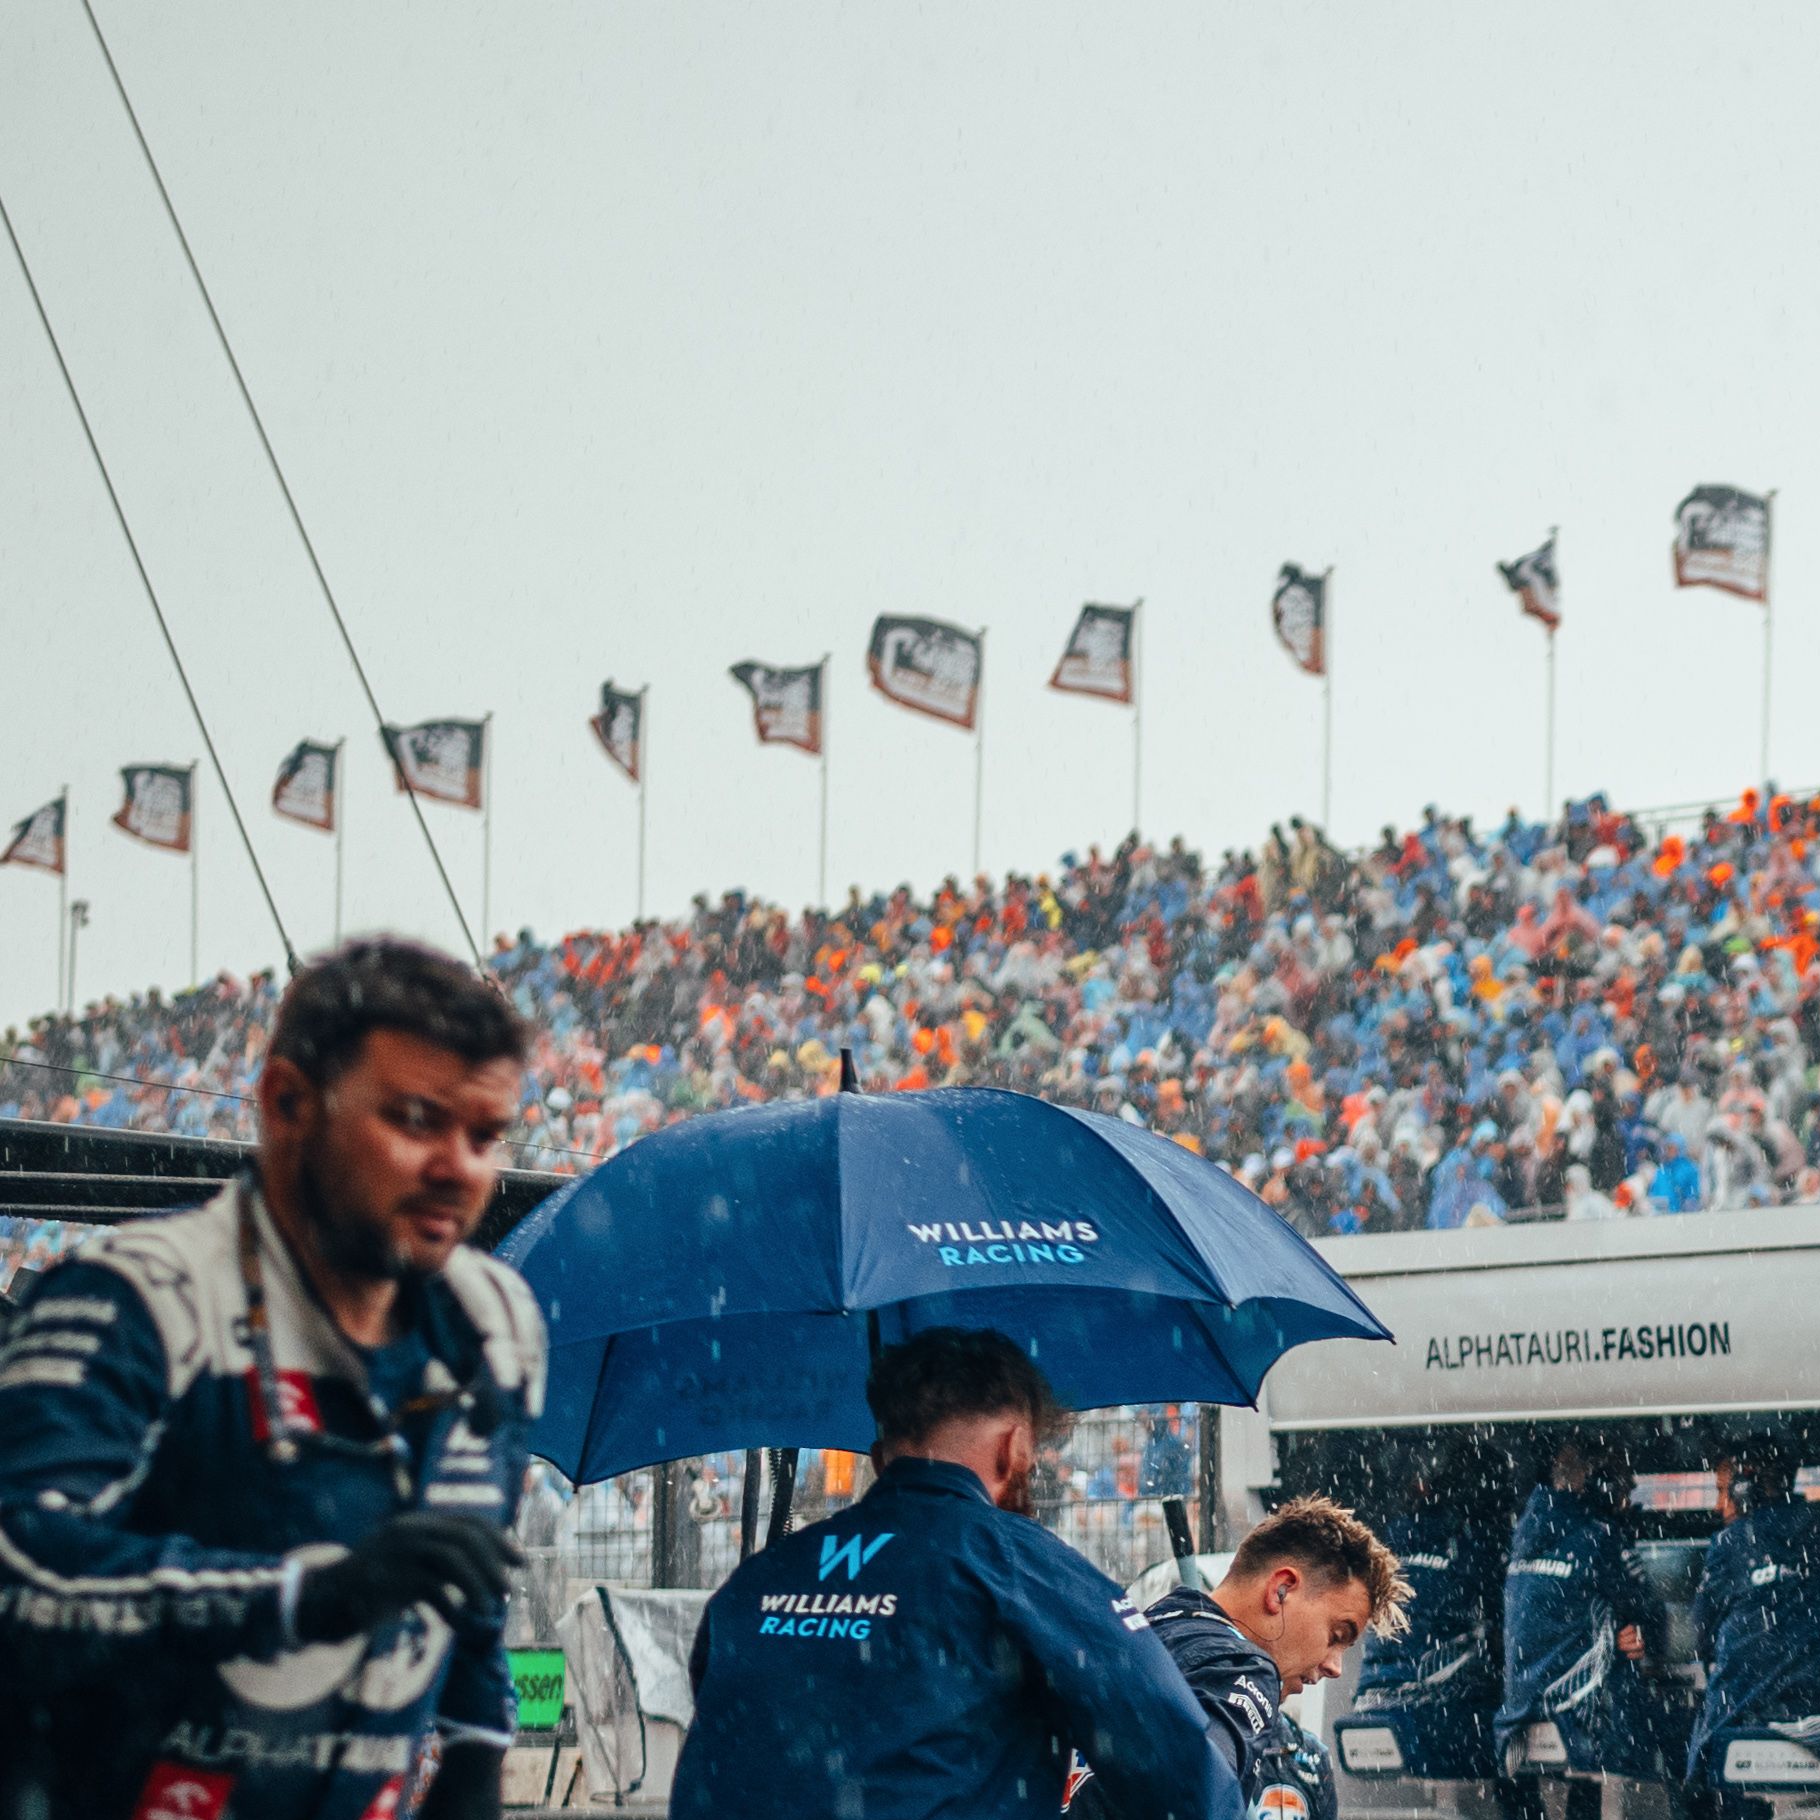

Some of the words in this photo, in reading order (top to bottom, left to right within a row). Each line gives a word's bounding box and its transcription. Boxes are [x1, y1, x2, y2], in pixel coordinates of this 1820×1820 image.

[908, 1219, 1099, 1243] WILLIAMS
[938, 1243, 1085, 1267] RACING
[1426, 1321, 1731, 1370] ALPHATAURI.FASHION
[760, 1594, 898, 1616] WILLIAMS
[759, 1616, 871, 1640] RACING
[1233, 1675, 1273, 1718] Acronis
[1228, 1692, 1266, 1735] PIRELLI
